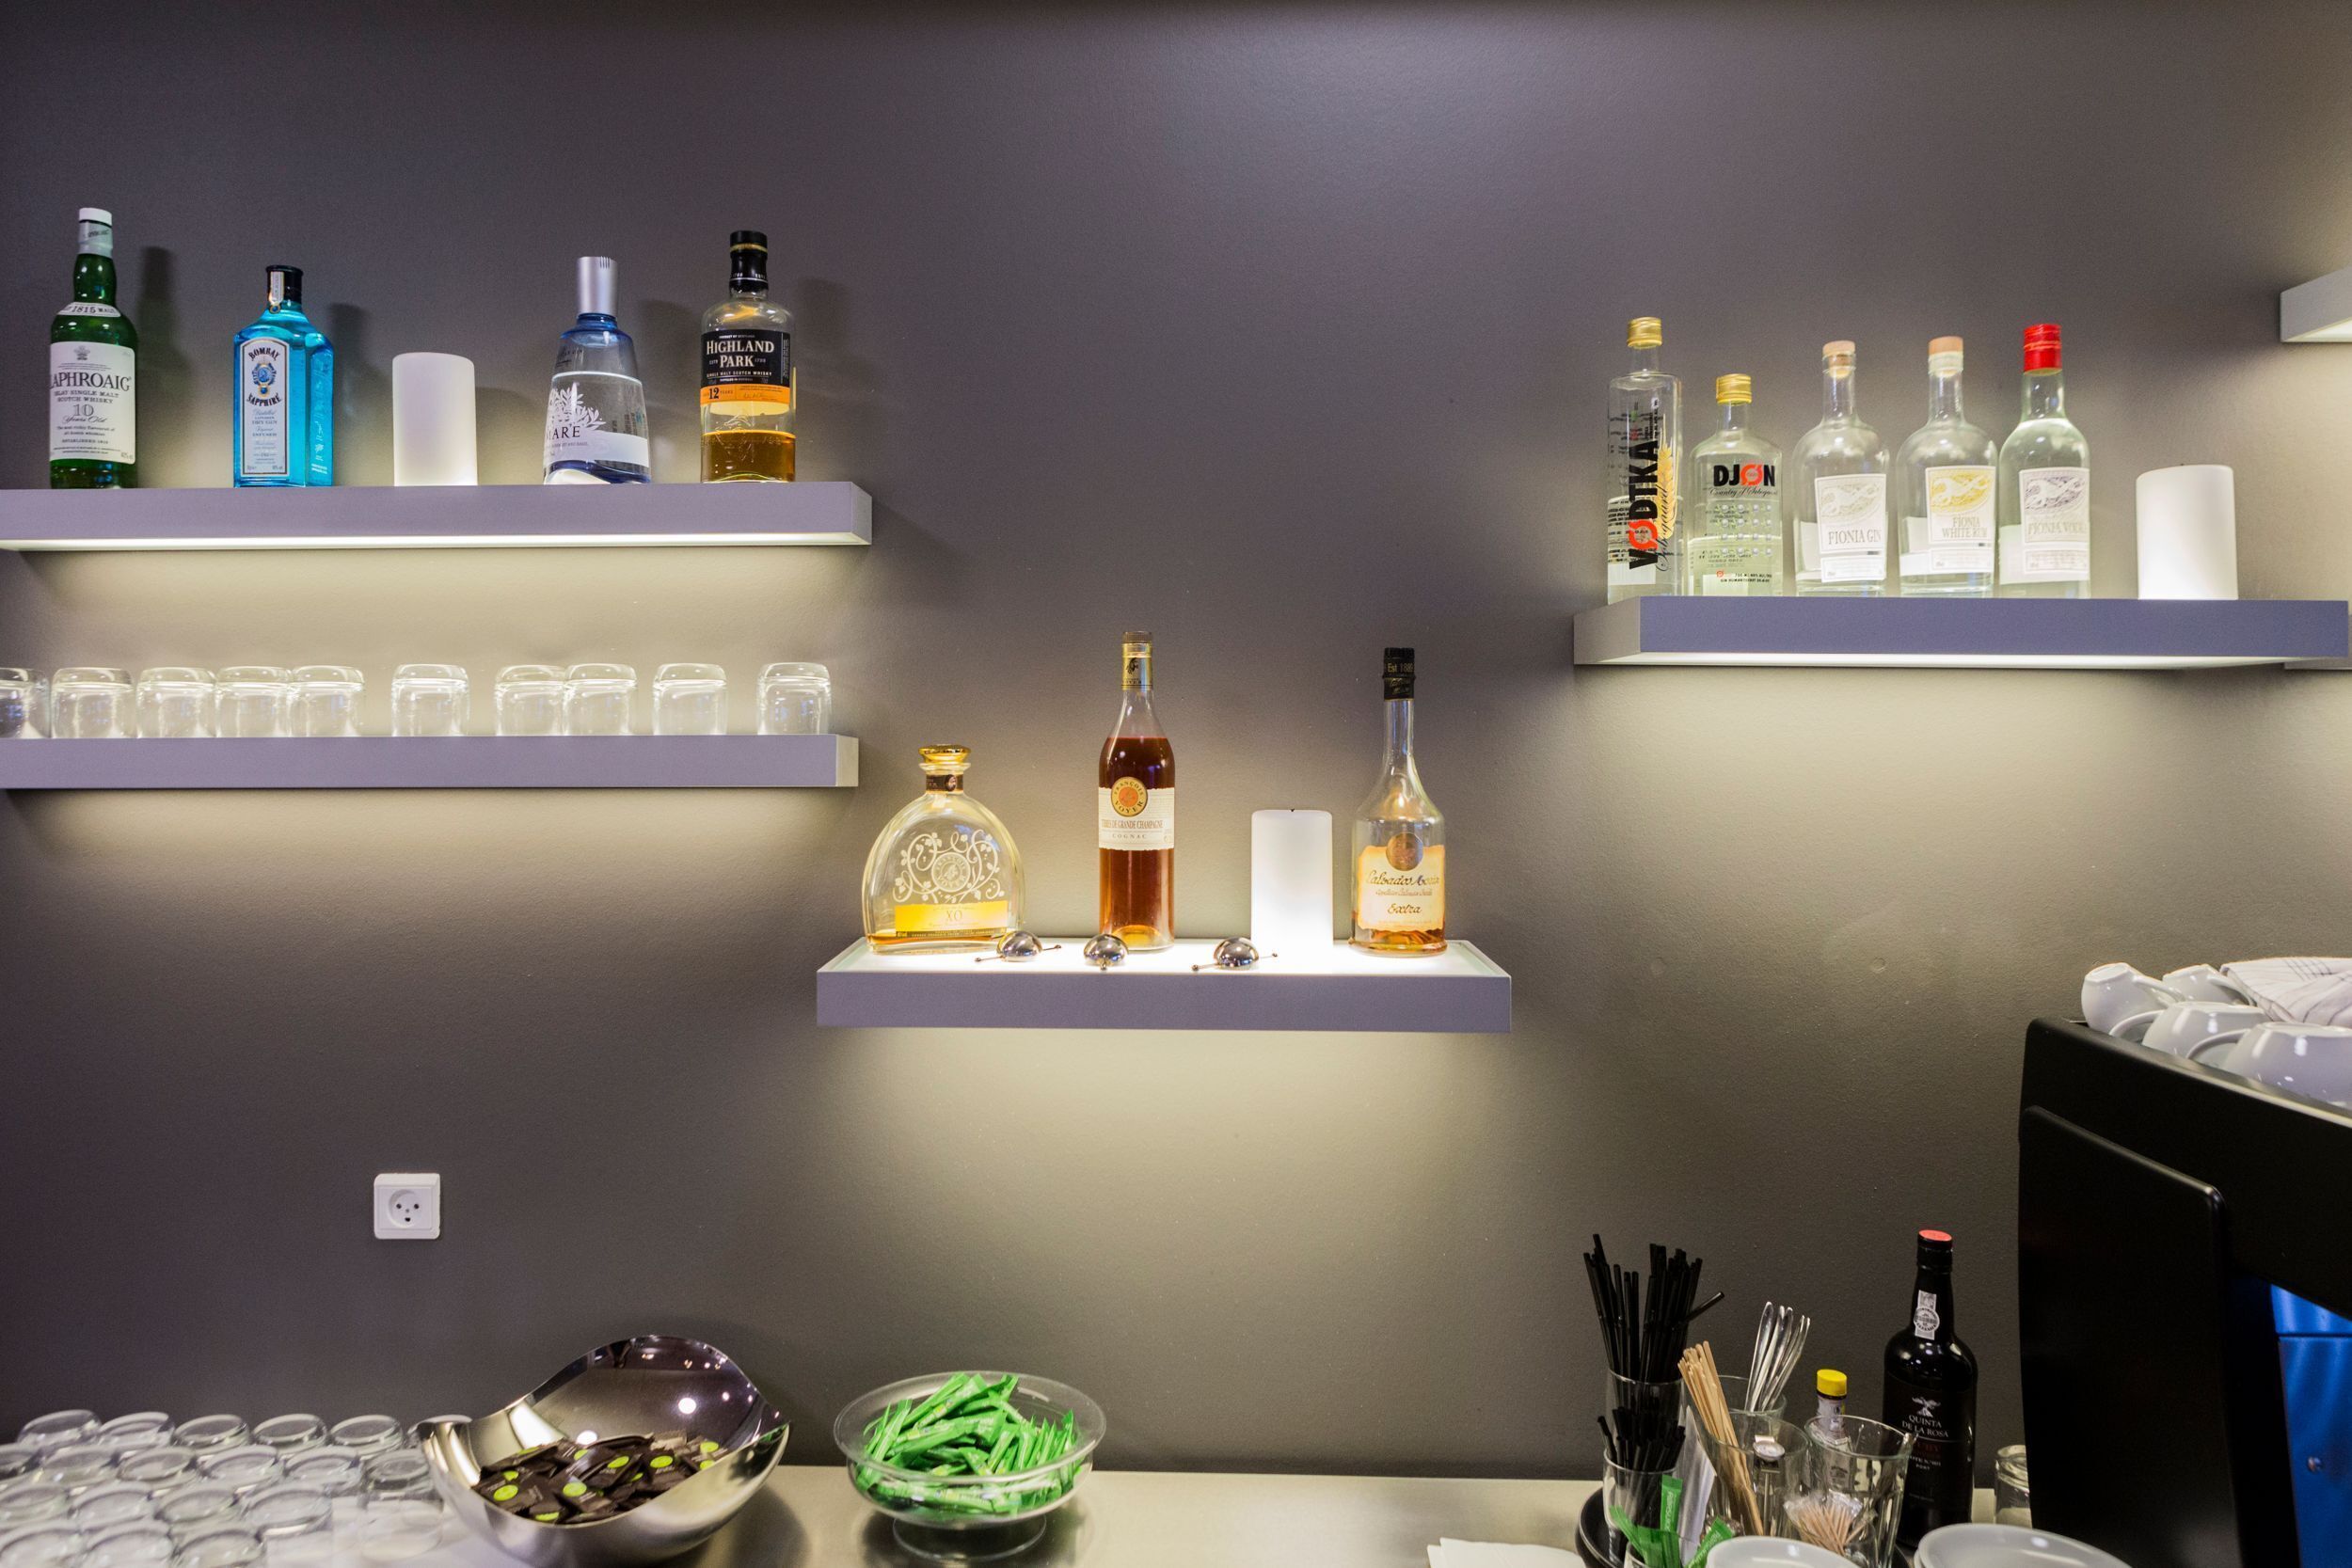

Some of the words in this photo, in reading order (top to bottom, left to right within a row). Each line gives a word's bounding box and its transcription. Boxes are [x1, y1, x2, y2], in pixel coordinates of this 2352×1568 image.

[248, 347, 280, 361] BOMBAY
[707, 341, 775, 356] HIGHLAND
[720, 356, 755, 368] PARK
[49, 372, 131, 391] APHROAIG
[246, 392, 282, 406] SAPPHIRE
[708, 388, 720, 399] 12
[72, 404, 95, 417] 10
[1828, 530, 1866, 545] FIONIA
[1942, 527, 1972, 538] WHITE
[1114, 800, 1144, 814] VOYER
[1387, 903, 1422, 914] Extra
[946, 910, 963, 922] XO
[1908, 1414, 1943, 1428] QUINTA
[1901, 1420, 1913, 1431] DE
[1914, 1424, 1926, 1434] LA
[1927, 1428, 1949, 1438] ROSA
